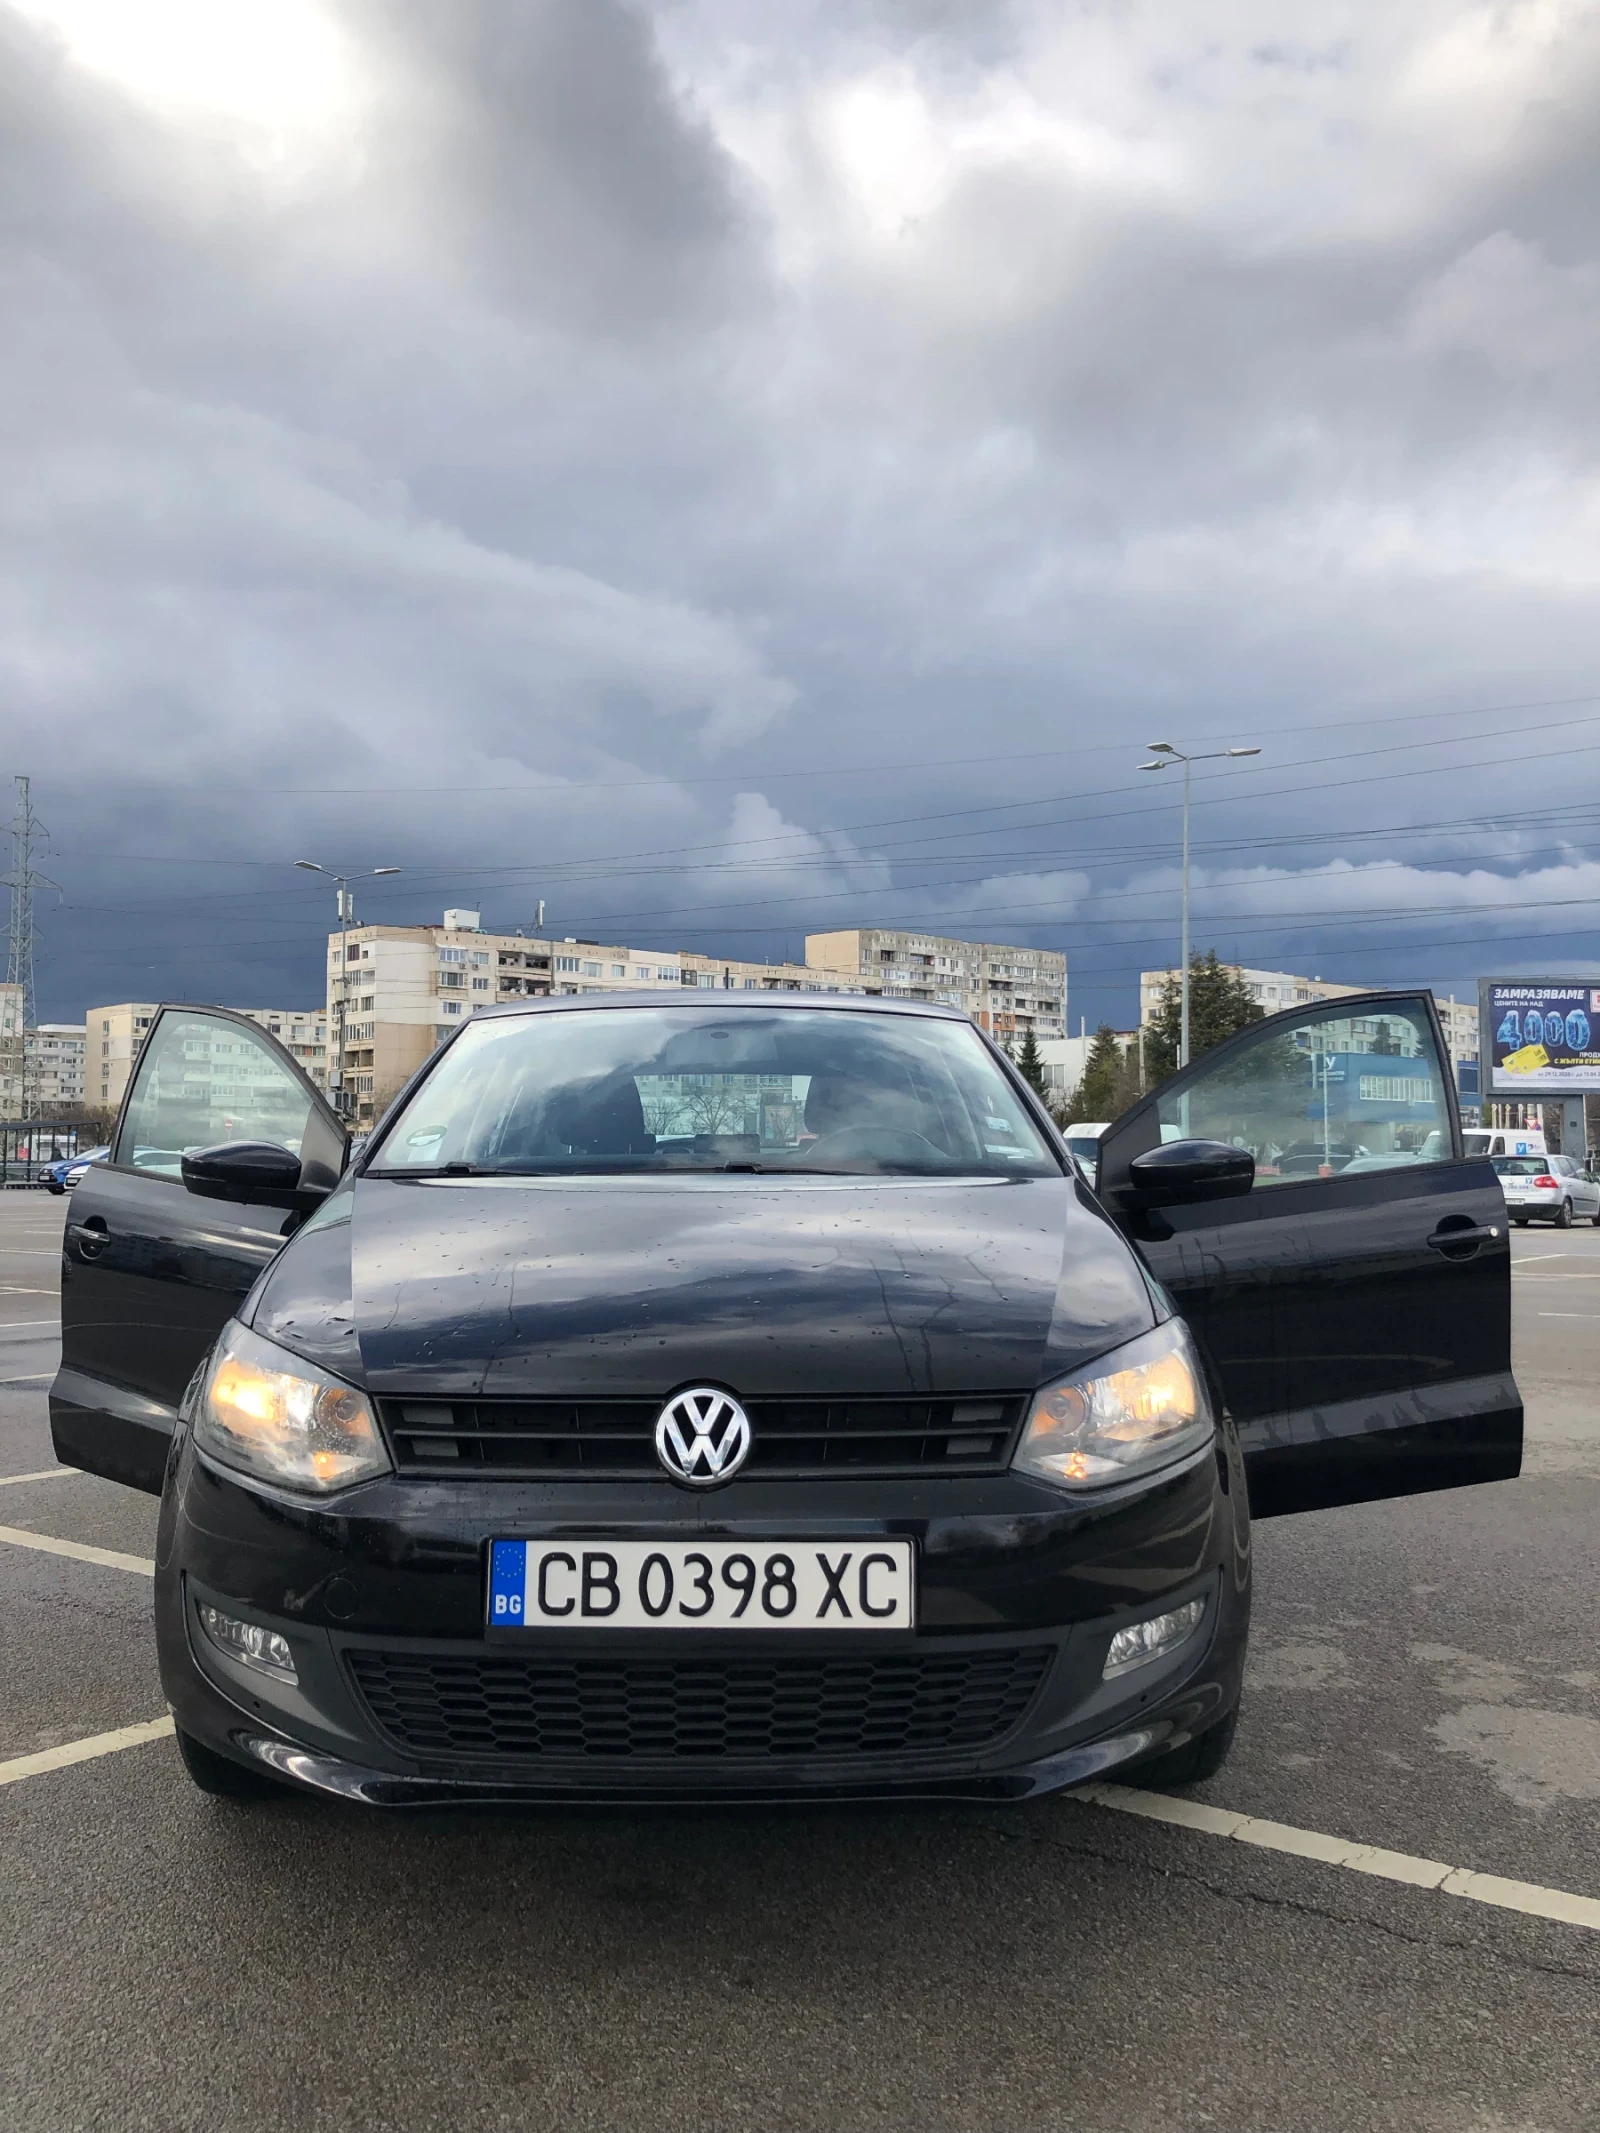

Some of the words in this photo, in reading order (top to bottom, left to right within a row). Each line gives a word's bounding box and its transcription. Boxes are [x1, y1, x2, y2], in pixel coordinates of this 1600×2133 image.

[1494, 988, 1585, 1000] ЗАМРАЗЯВАМЕ
[1496, 1009, 1591, 1051] 4000
[538, 1552, 620, 1616] CB
[638, 1552, 797, 1618] 0398
[815, 1553, 897, 1618] XC
[495, 1594, 521, 1615] BG
